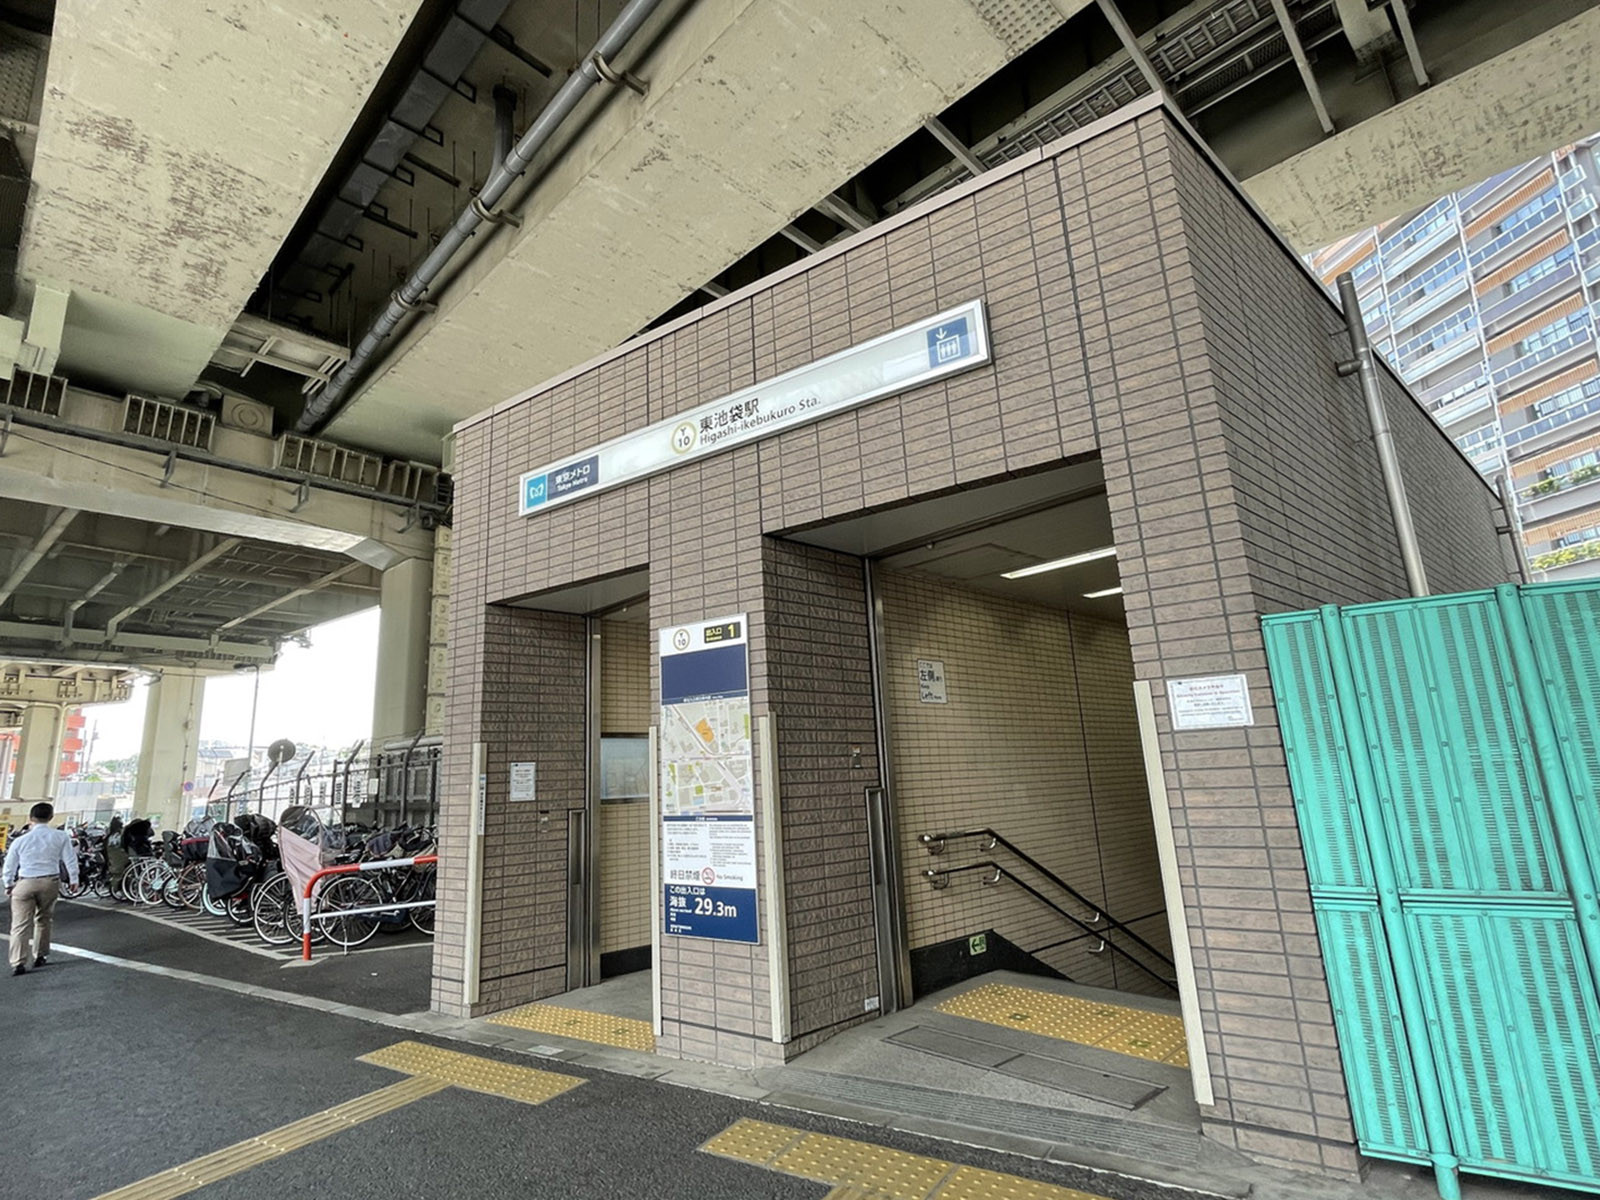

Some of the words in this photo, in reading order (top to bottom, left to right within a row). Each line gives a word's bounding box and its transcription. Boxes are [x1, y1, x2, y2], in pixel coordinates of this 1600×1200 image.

[699, 398, 760, 434] 東池袋駅
[700, 405, 796, 445] Higashi-ikebukuro
[799, 396, 821, 411] Sta.
[680, 427, 687, 437] Y
[678, 435, 690, 448] 10
[556, 464, 591, 485] 東京メトロ
[727, 623, 735, 638] 1
[677, 638, 686, 646] 10
[723, 874, 744, 882] Smoking
[669, 885, 706, 895] この出入口は
[694, 897, 737, 918] 29.3m
